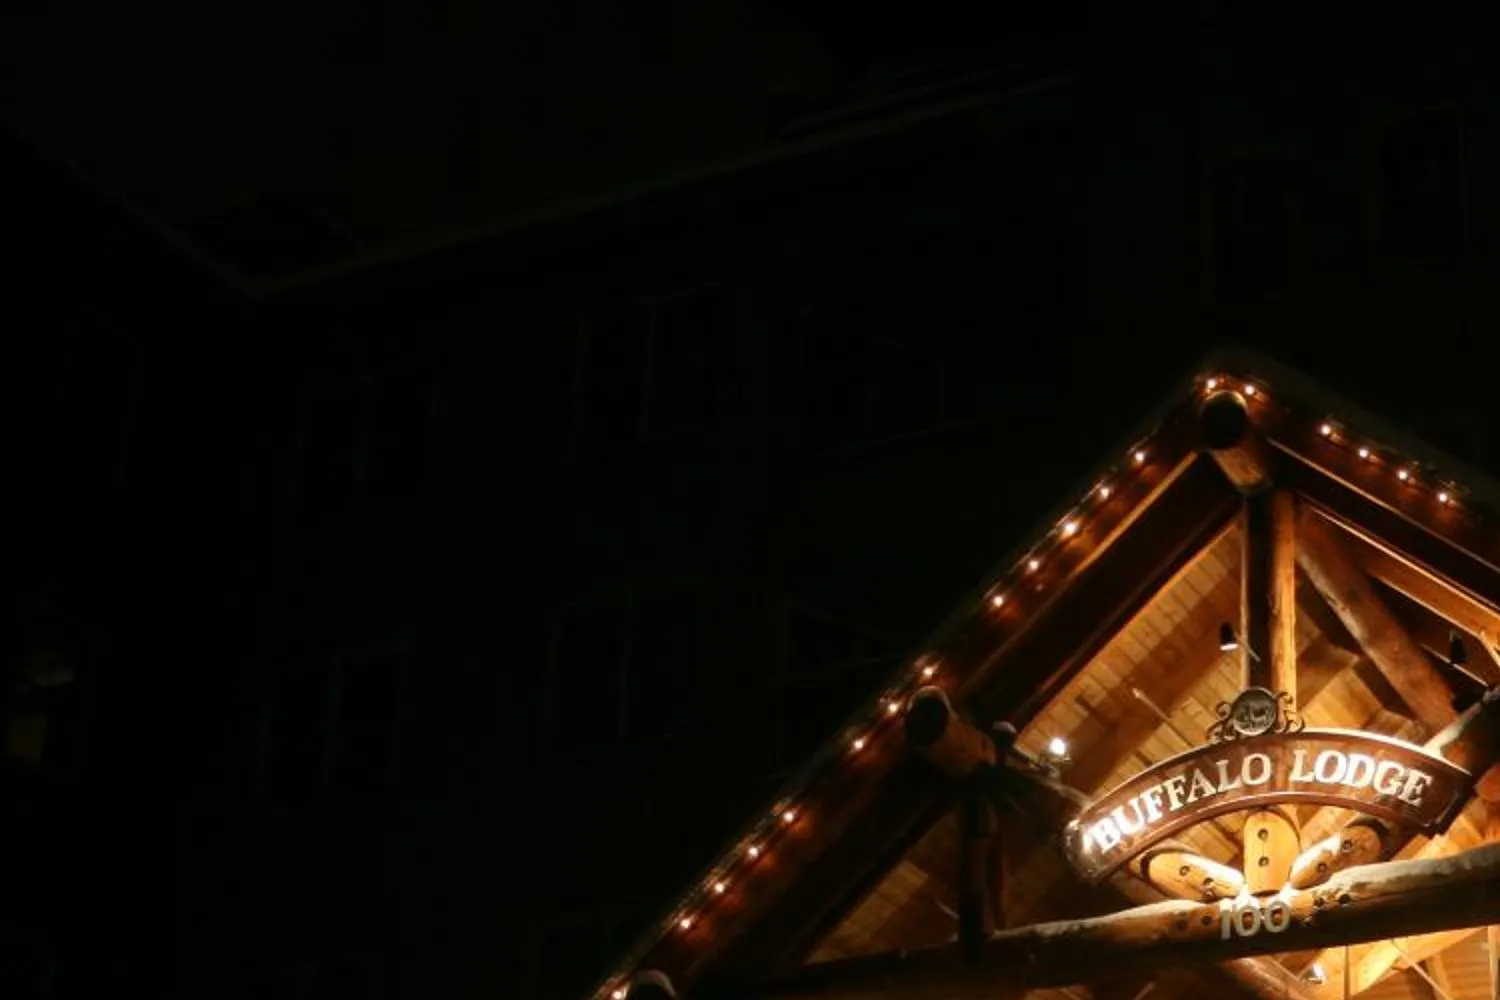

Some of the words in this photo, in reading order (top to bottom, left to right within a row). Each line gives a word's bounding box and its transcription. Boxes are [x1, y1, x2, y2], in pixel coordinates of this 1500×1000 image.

[1086, 753, 1272, 855] BUFFALO
[1289, 748, 1433, 806] LODGE
[1219, 899, 1290, 940] 100
